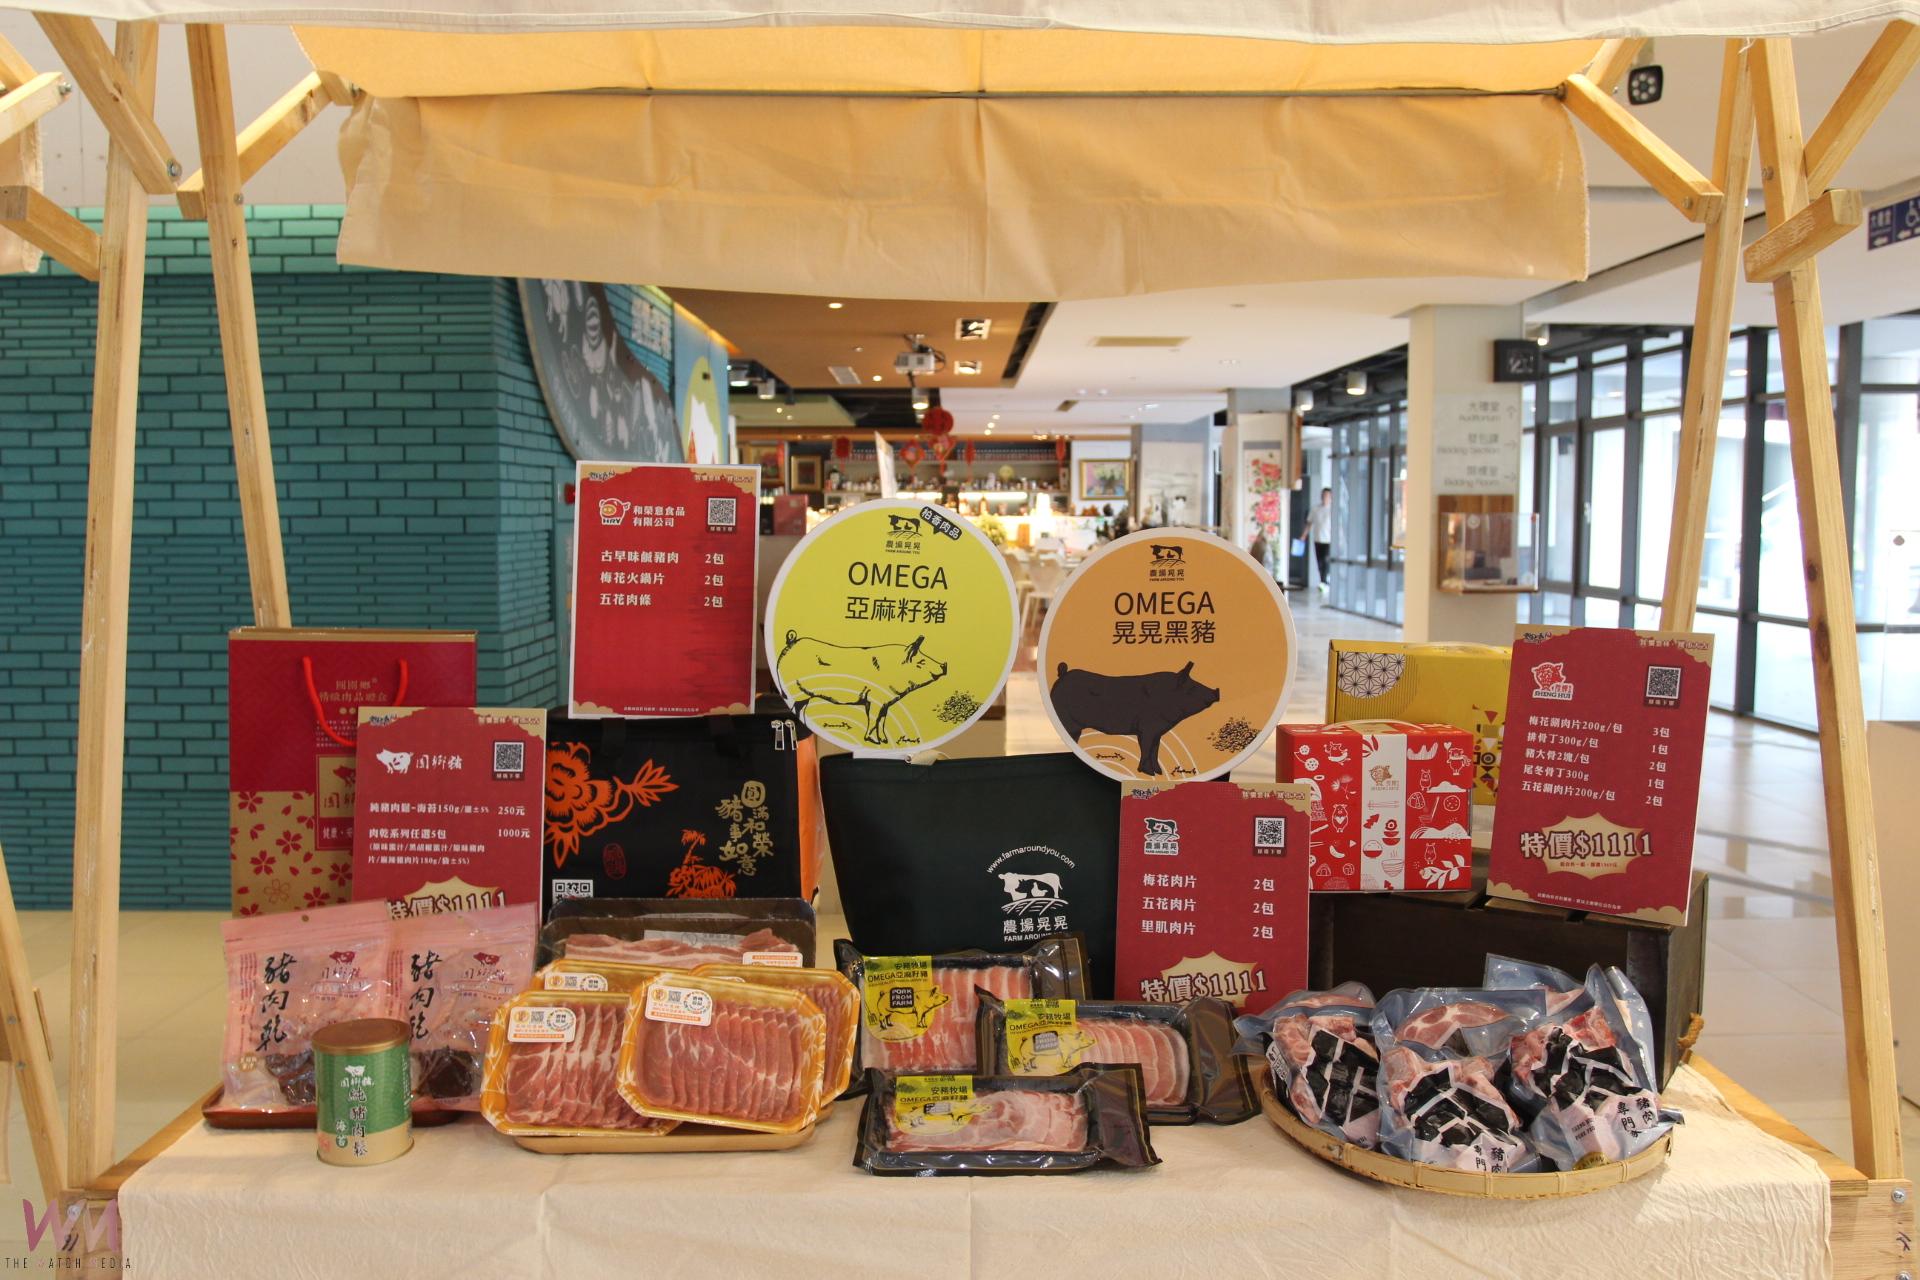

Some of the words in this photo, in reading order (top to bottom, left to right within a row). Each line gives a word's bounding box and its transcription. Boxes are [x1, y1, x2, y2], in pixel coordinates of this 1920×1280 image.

[633, 505, 685, 517] 和榮意食品
[633, 516, 674, 528] 有限公司
[600, 550, 679, 564] 古早味鹹豬肉
[704, 553, 724, 565] 2包
[600, 572, 664, 585] 梅花火鍋片
[704, 574, 724, 586] 2包
[848, 562, 948, 590] OMEGA
[599, 593, 652, 607] 五花肉條
[704, 595, 723, 608] 2包
[845, 596, 948, 624] 亞麻籽豬
[1114, 591, 1215, 615] OMEGA
[1112, 620, 1216, 644] 晃晃黑豬
[1653, 727, 1670, 738] 3包
[1527, 732, 1598, 748] 排骨丁300g/包
[1652, 744, 1668, 755] 1包
[1525, 749, 1590, 764] 豬大骨2塊/包
[1650, 761, 1666, 773] 2包
[1524, 764, 1590, 782] 尾冬骨丁300g
[1648, 778, 1664, 790] 1包
[498, 806, 526, 816] 250元
[1645, 795, 1663, 807] 2包
[498, 828, 531, 838] 1000元
[1520, 830, 1652, 860] 特價$1111
[986, 845, 1076, 874] www.farmaroundyou.com
[1143, 874, 1197, 888] 梅花肉片
[1253, 878, 1275, 891] 2包
[1142, 897, 1196, 912] 五花肉片
[1253, 902, 1274, 916] 2包
[1004, 915, 1068, 934] 農場晃晃
[1141, 920, 1196, 935] 里肌肉片
[1252, 926, 1273, 939] 2包
[1140, 970, 1267, 1002] 特價$1111
[256, 952, 297, 1052] 豬肉乾
[1636, 1097, 1654, 1124] 豬肉
[1491, 1147, 1504, 1172] 豬肉
